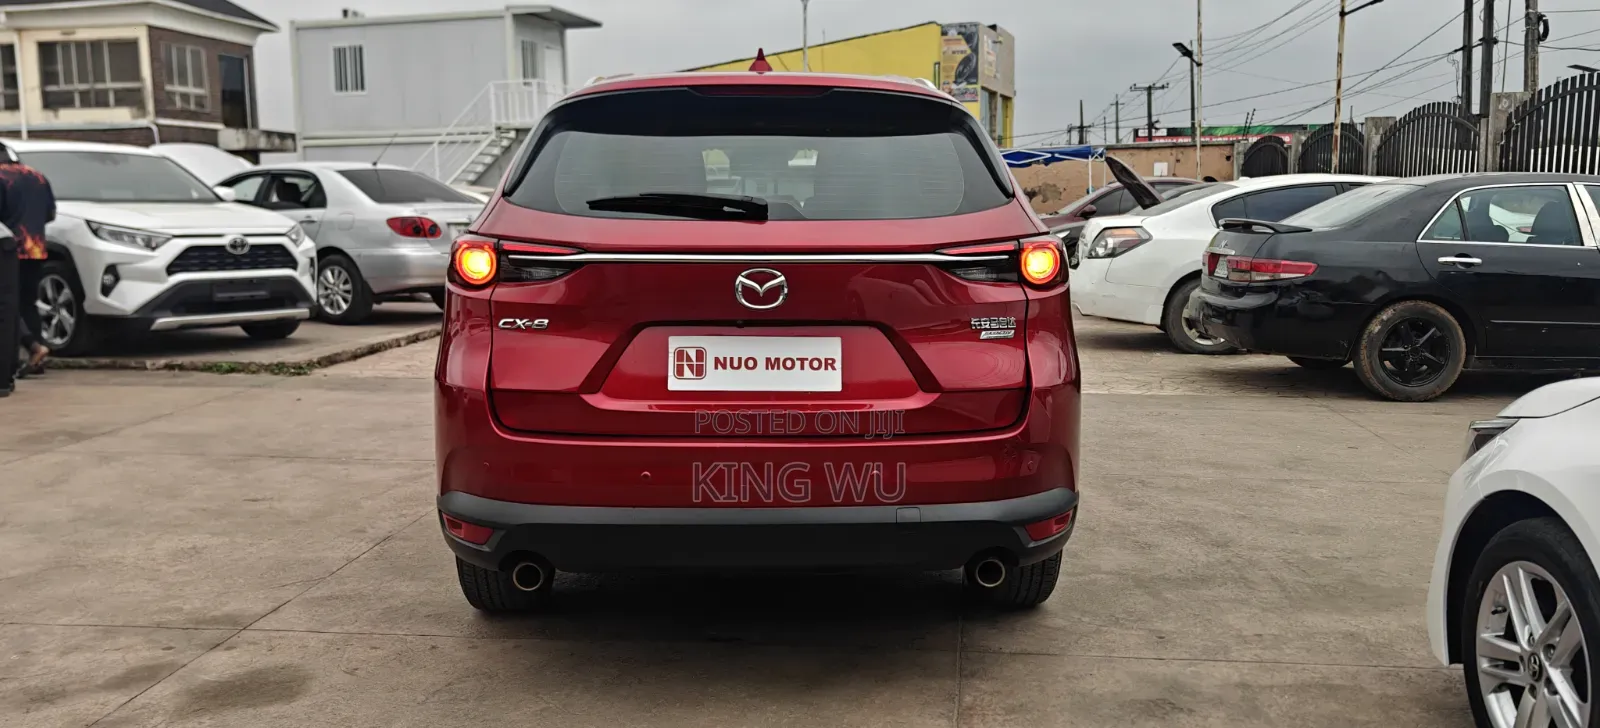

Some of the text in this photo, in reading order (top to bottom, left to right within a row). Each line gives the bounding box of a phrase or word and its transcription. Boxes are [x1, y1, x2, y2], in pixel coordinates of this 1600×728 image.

[498, 318, 549, 330] CX-8
[713, 356, 758, 371] NUO
[765, 357, 837, 371] MOTOR
